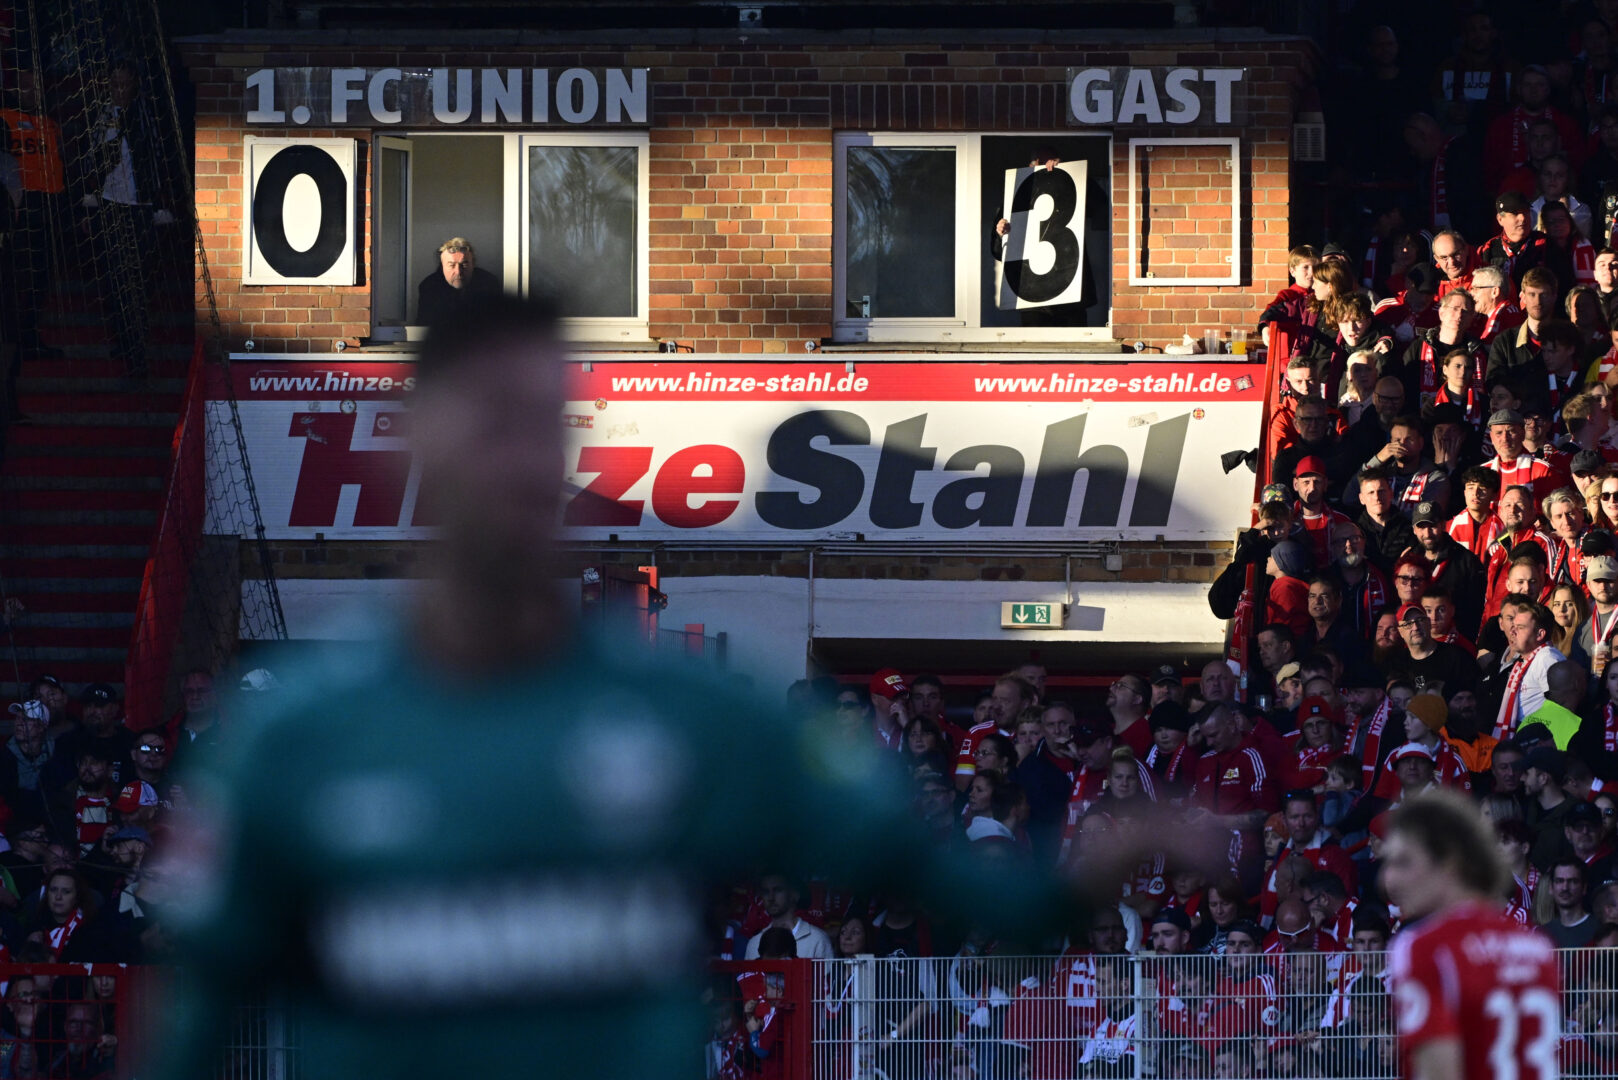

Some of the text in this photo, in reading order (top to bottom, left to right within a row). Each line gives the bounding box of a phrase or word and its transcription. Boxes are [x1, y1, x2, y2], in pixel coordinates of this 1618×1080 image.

[246, 68, 648, 125] 1. FC UNION
[1070, 68, 1244, 124] GAST
[252, 144, 348, 278] 0
[1003, 167, 1080, 303] 3
[249, 371, 416, 393] www.hinze-s
[611, 372, 869, 393] www.hinze-stahl.de
[973, 372, 1232, 393] www.hinze-stahl.de
